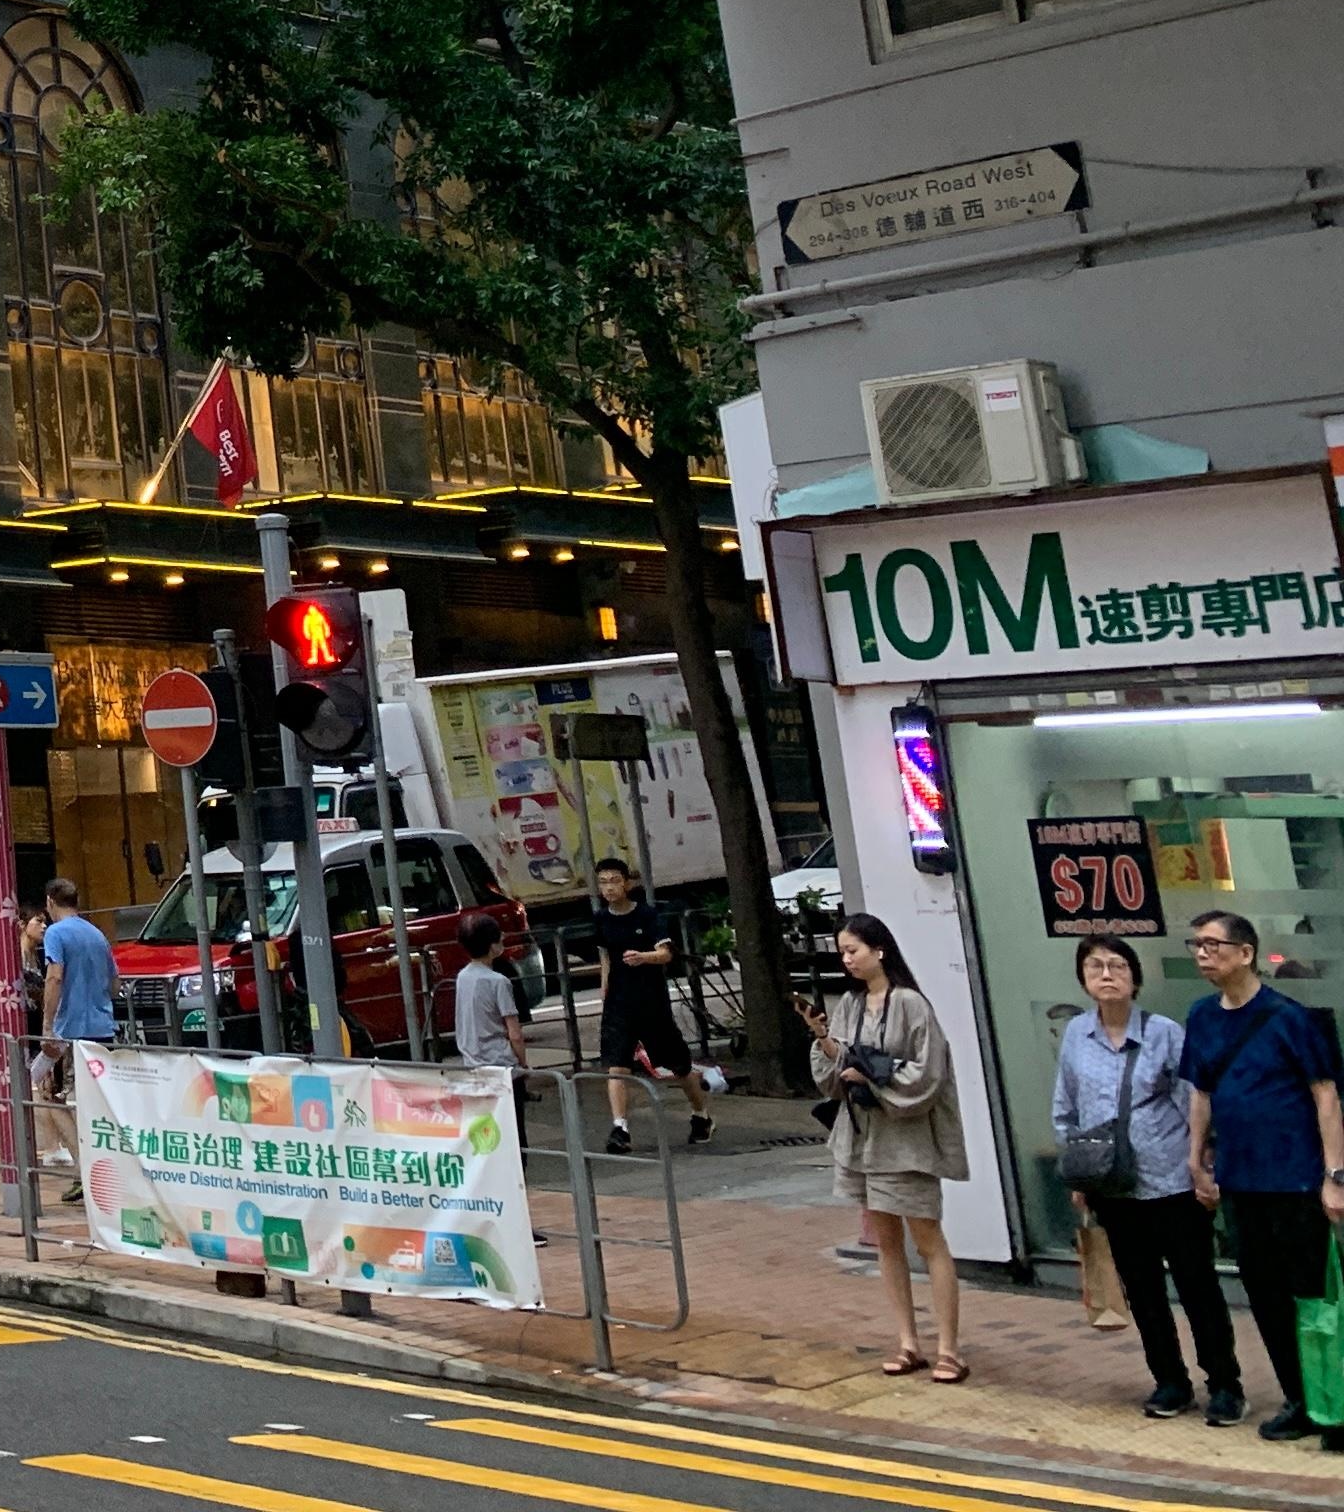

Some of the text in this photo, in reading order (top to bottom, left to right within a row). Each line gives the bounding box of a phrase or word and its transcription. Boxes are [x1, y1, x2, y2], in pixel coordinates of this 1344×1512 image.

[820, 161, 1035, 218] Des Voeux Road West
[875, 198, 986, 239] 德輔道西
[219, 429, 239, 461] Best
[824, 531, 1081, 663] 10M
[1050, 853, 1146, 914] $70
[91, 1117, 465, 1189] 完善地區治理 建設社區幫到你
[189, 1170, 234, 1190] District
[235, 1177, 329, 1200] Administration
[339, 1185, 369, 1204] Build
[370, 1194, 378, 1204] a
[381, 1190, 425, 1209] Better
[428, 1193, 504, 1217] Community
